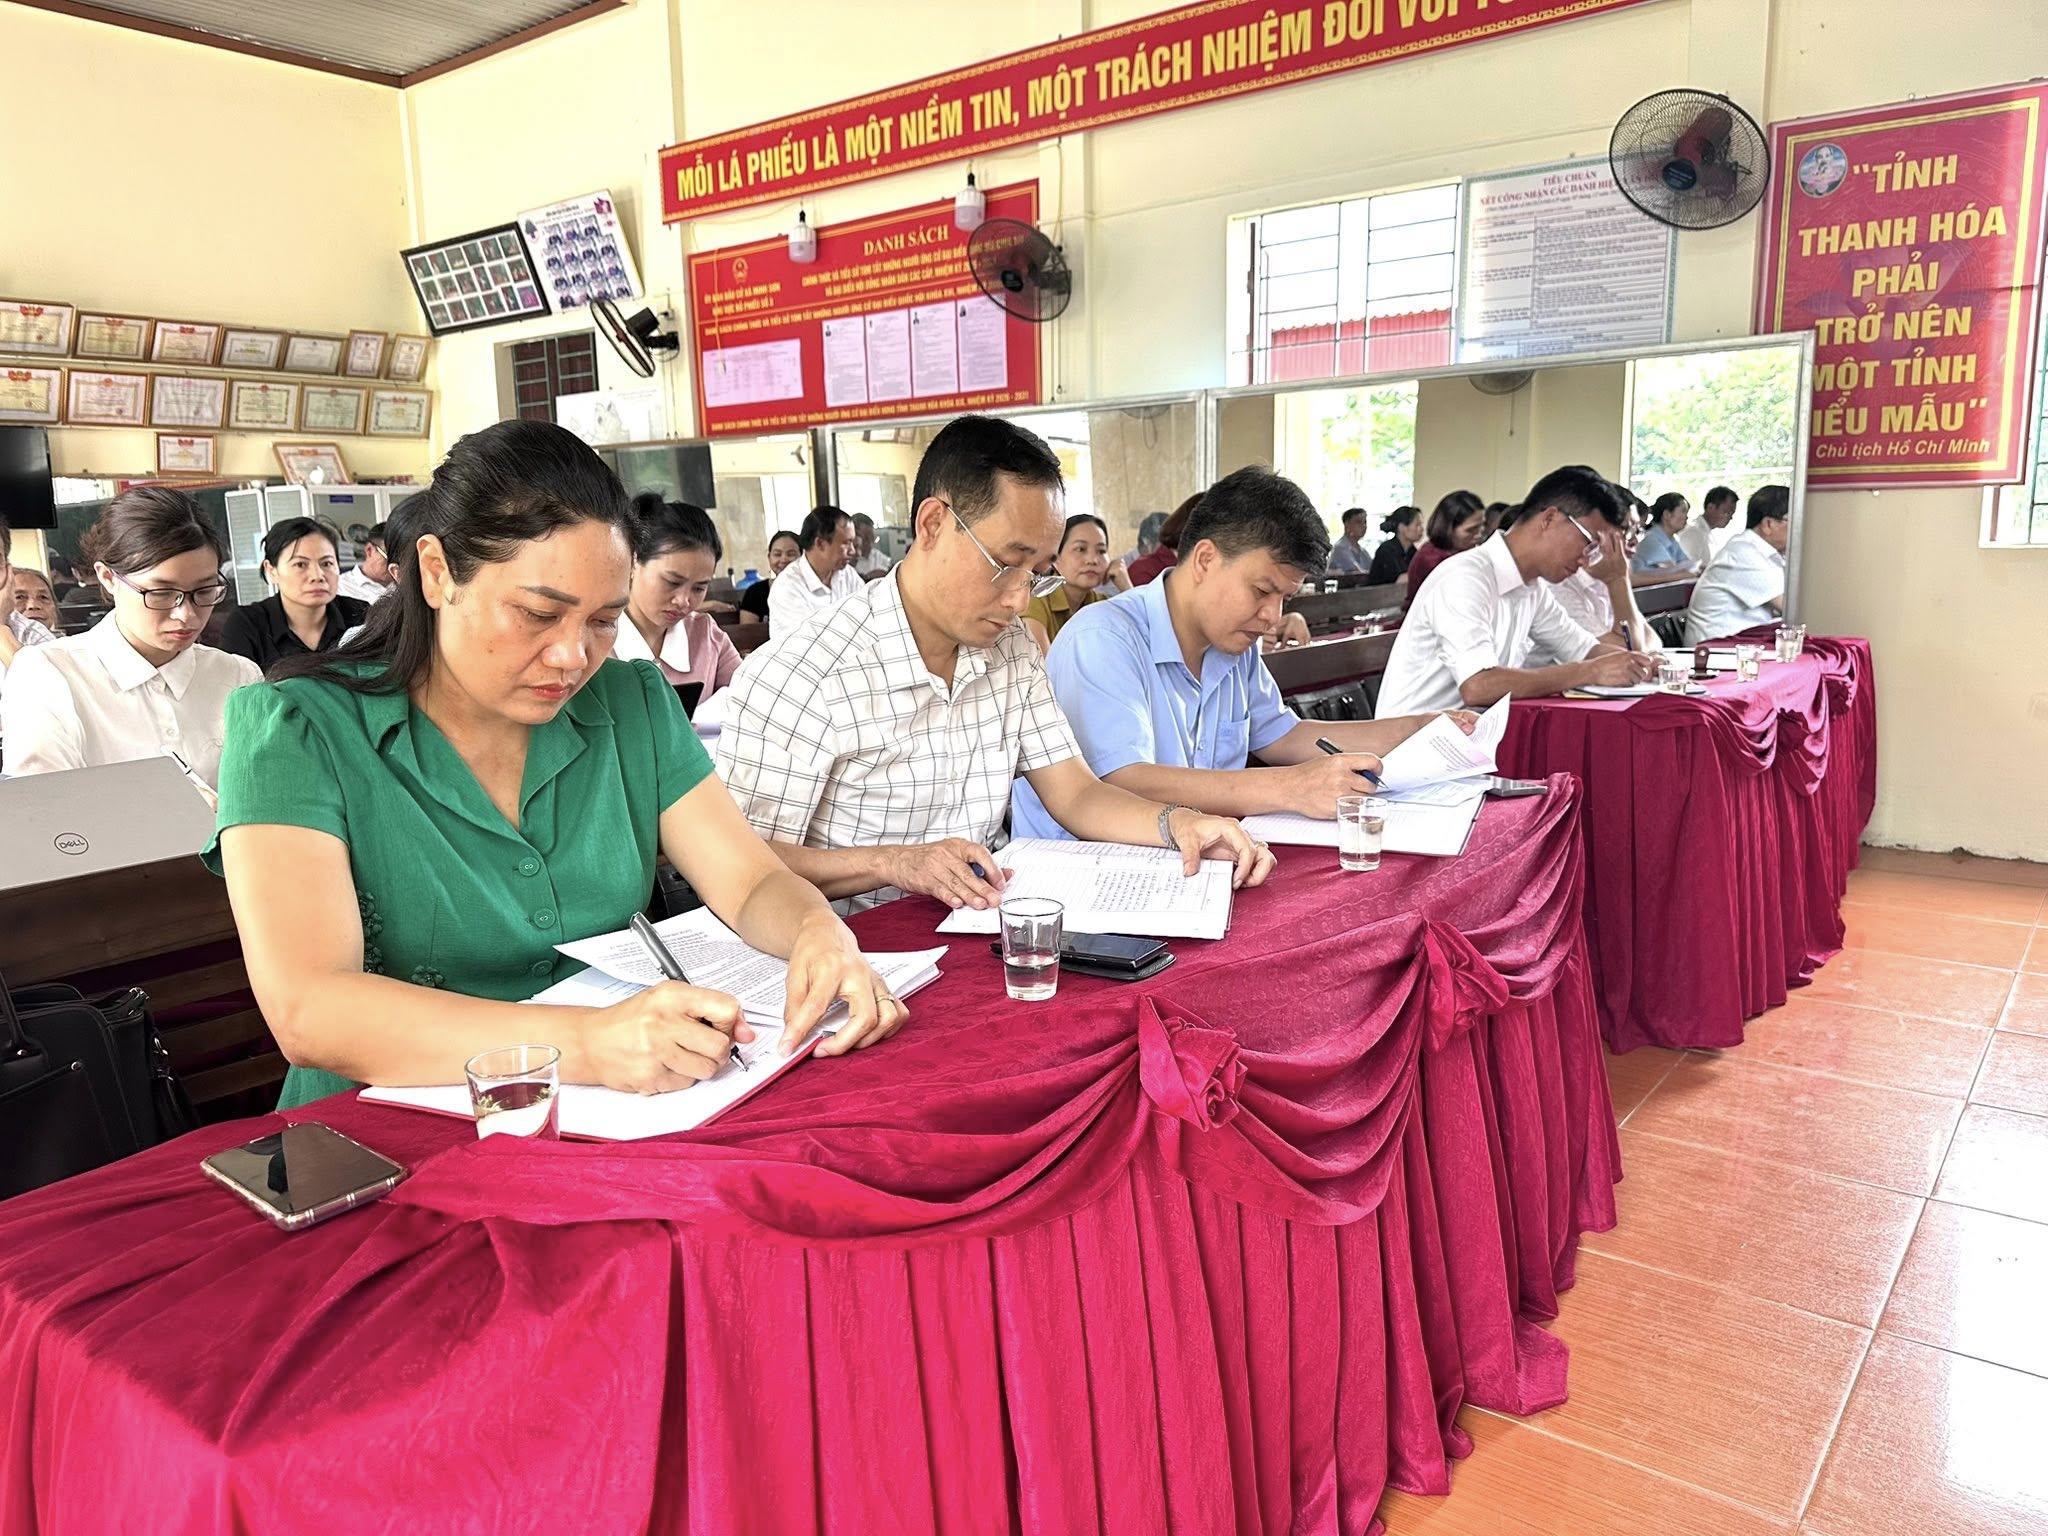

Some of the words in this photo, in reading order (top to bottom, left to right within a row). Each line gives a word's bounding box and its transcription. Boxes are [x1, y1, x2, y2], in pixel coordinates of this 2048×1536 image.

[677, 152, 714, 202] MỖI
[718, 145, 743, 192] LÁ
[747, 130, 808, 186] PHIẾU
[813, 126, 840, 170] LÀ
[844, 111, 895, 166] MỘT
[899, 93, 964, 149] NIỀM
[969, 86, 1020, 128] TIN,
[1027, 63, 1086, 121] MỘT
[1096, 39, 1193, 102] TRÁCH
[1202, 9, 1312, 72] NHIỆM
[863, 233, 905, 256] DANH
[907, 225, 949, 247] SÁCH
[1798, 215, 1917, 257] THANH
[1928, 203, 2008, 241] HÓA
[1851, 251, 1940, 298] PHẢI
[1814, 303, 1885, 347] TRỞ
[1893, 305, 1972, 340] NÊN
[1813, 357, 1880, 396] MỘT
[1891, 347, 1977, 387] TỈNH
[1812, 397, 1868, 438] IỂU
[1815, 443, 1848, 458] Chủ
[1852, 441, 1883, 459] tịch
[1886, 438, 1911, 456] Hồ
[1915, 438, 1945, 455] Chí
[1949, 438, 1991, 454] Minh
[59, 839, 85, 849] DELL
